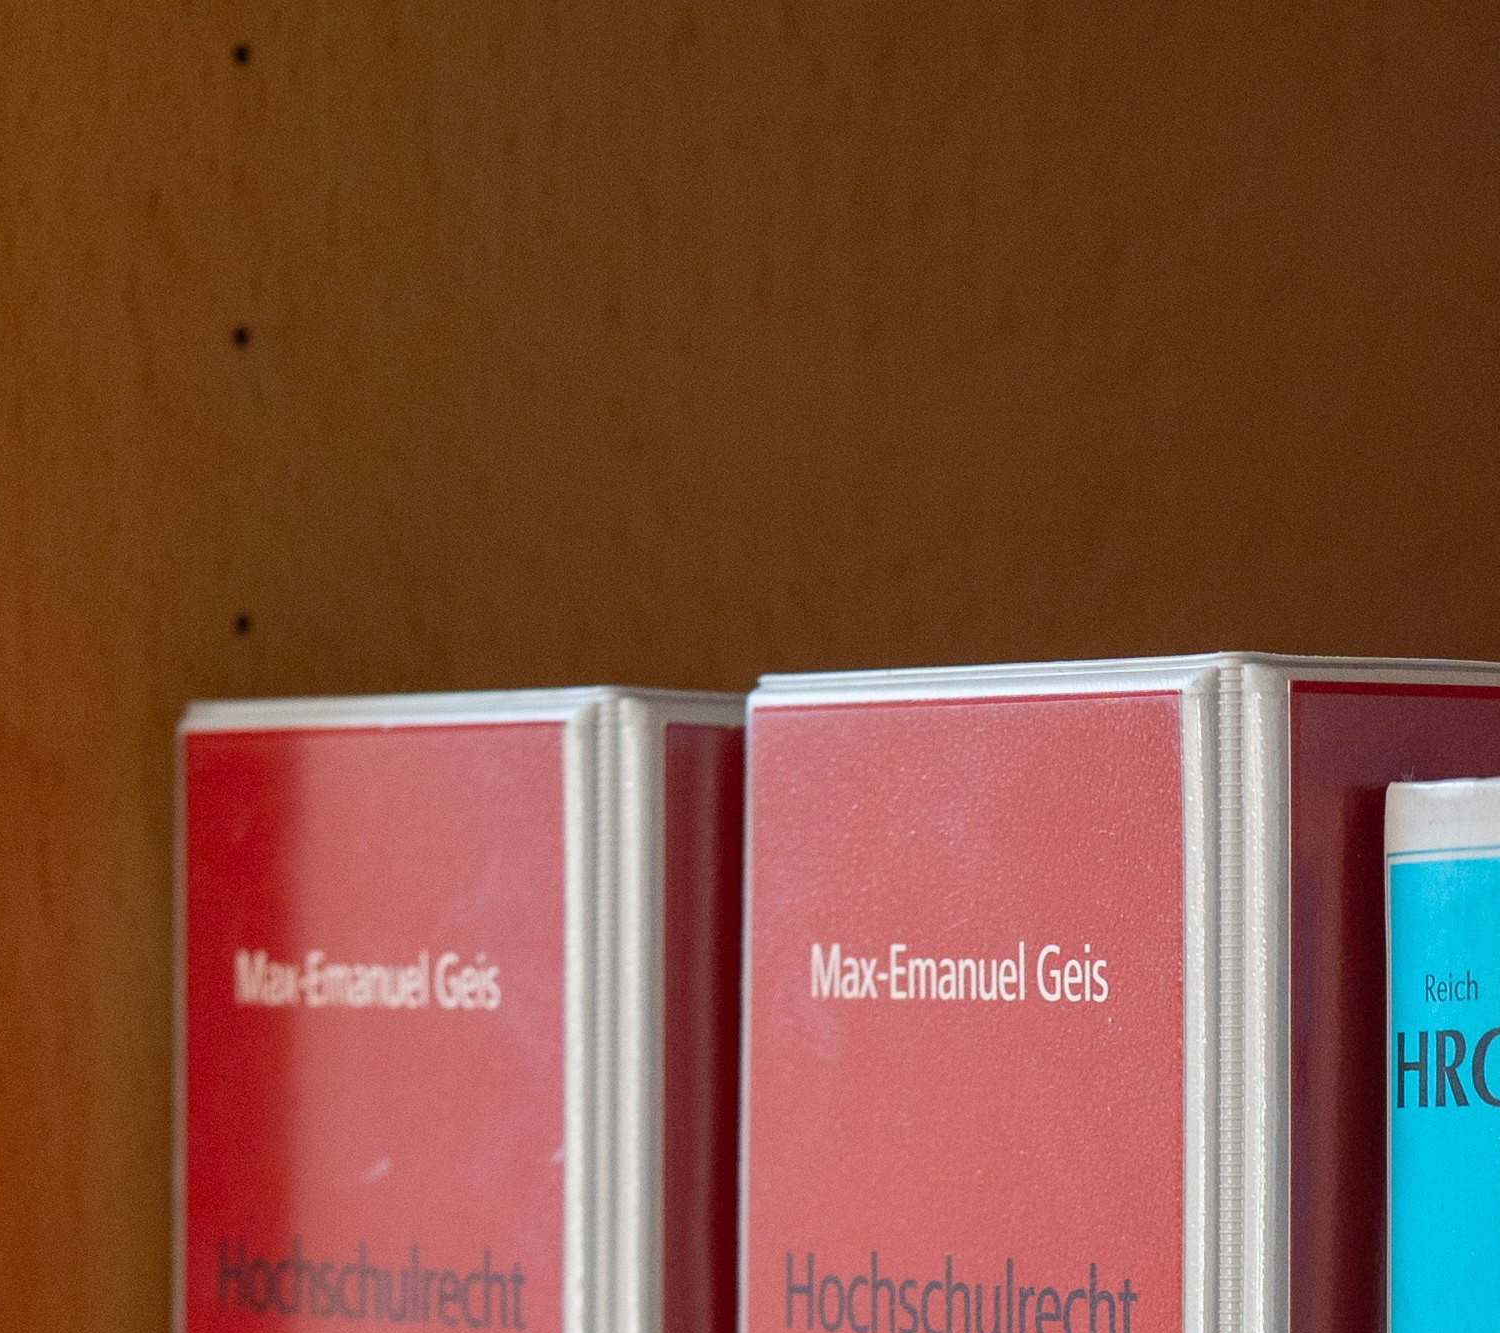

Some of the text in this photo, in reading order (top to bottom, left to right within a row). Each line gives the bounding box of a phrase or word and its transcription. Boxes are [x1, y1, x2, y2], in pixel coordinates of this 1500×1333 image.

[235, 950, 501, 1010] Max-Emanuel Geis
[810, 941, 1110, 1003] Max-Emanuel Geis
[1425, 970, 1479, 1003] Reich
[216, 1236, 526, 1332] Hochschulrecht
